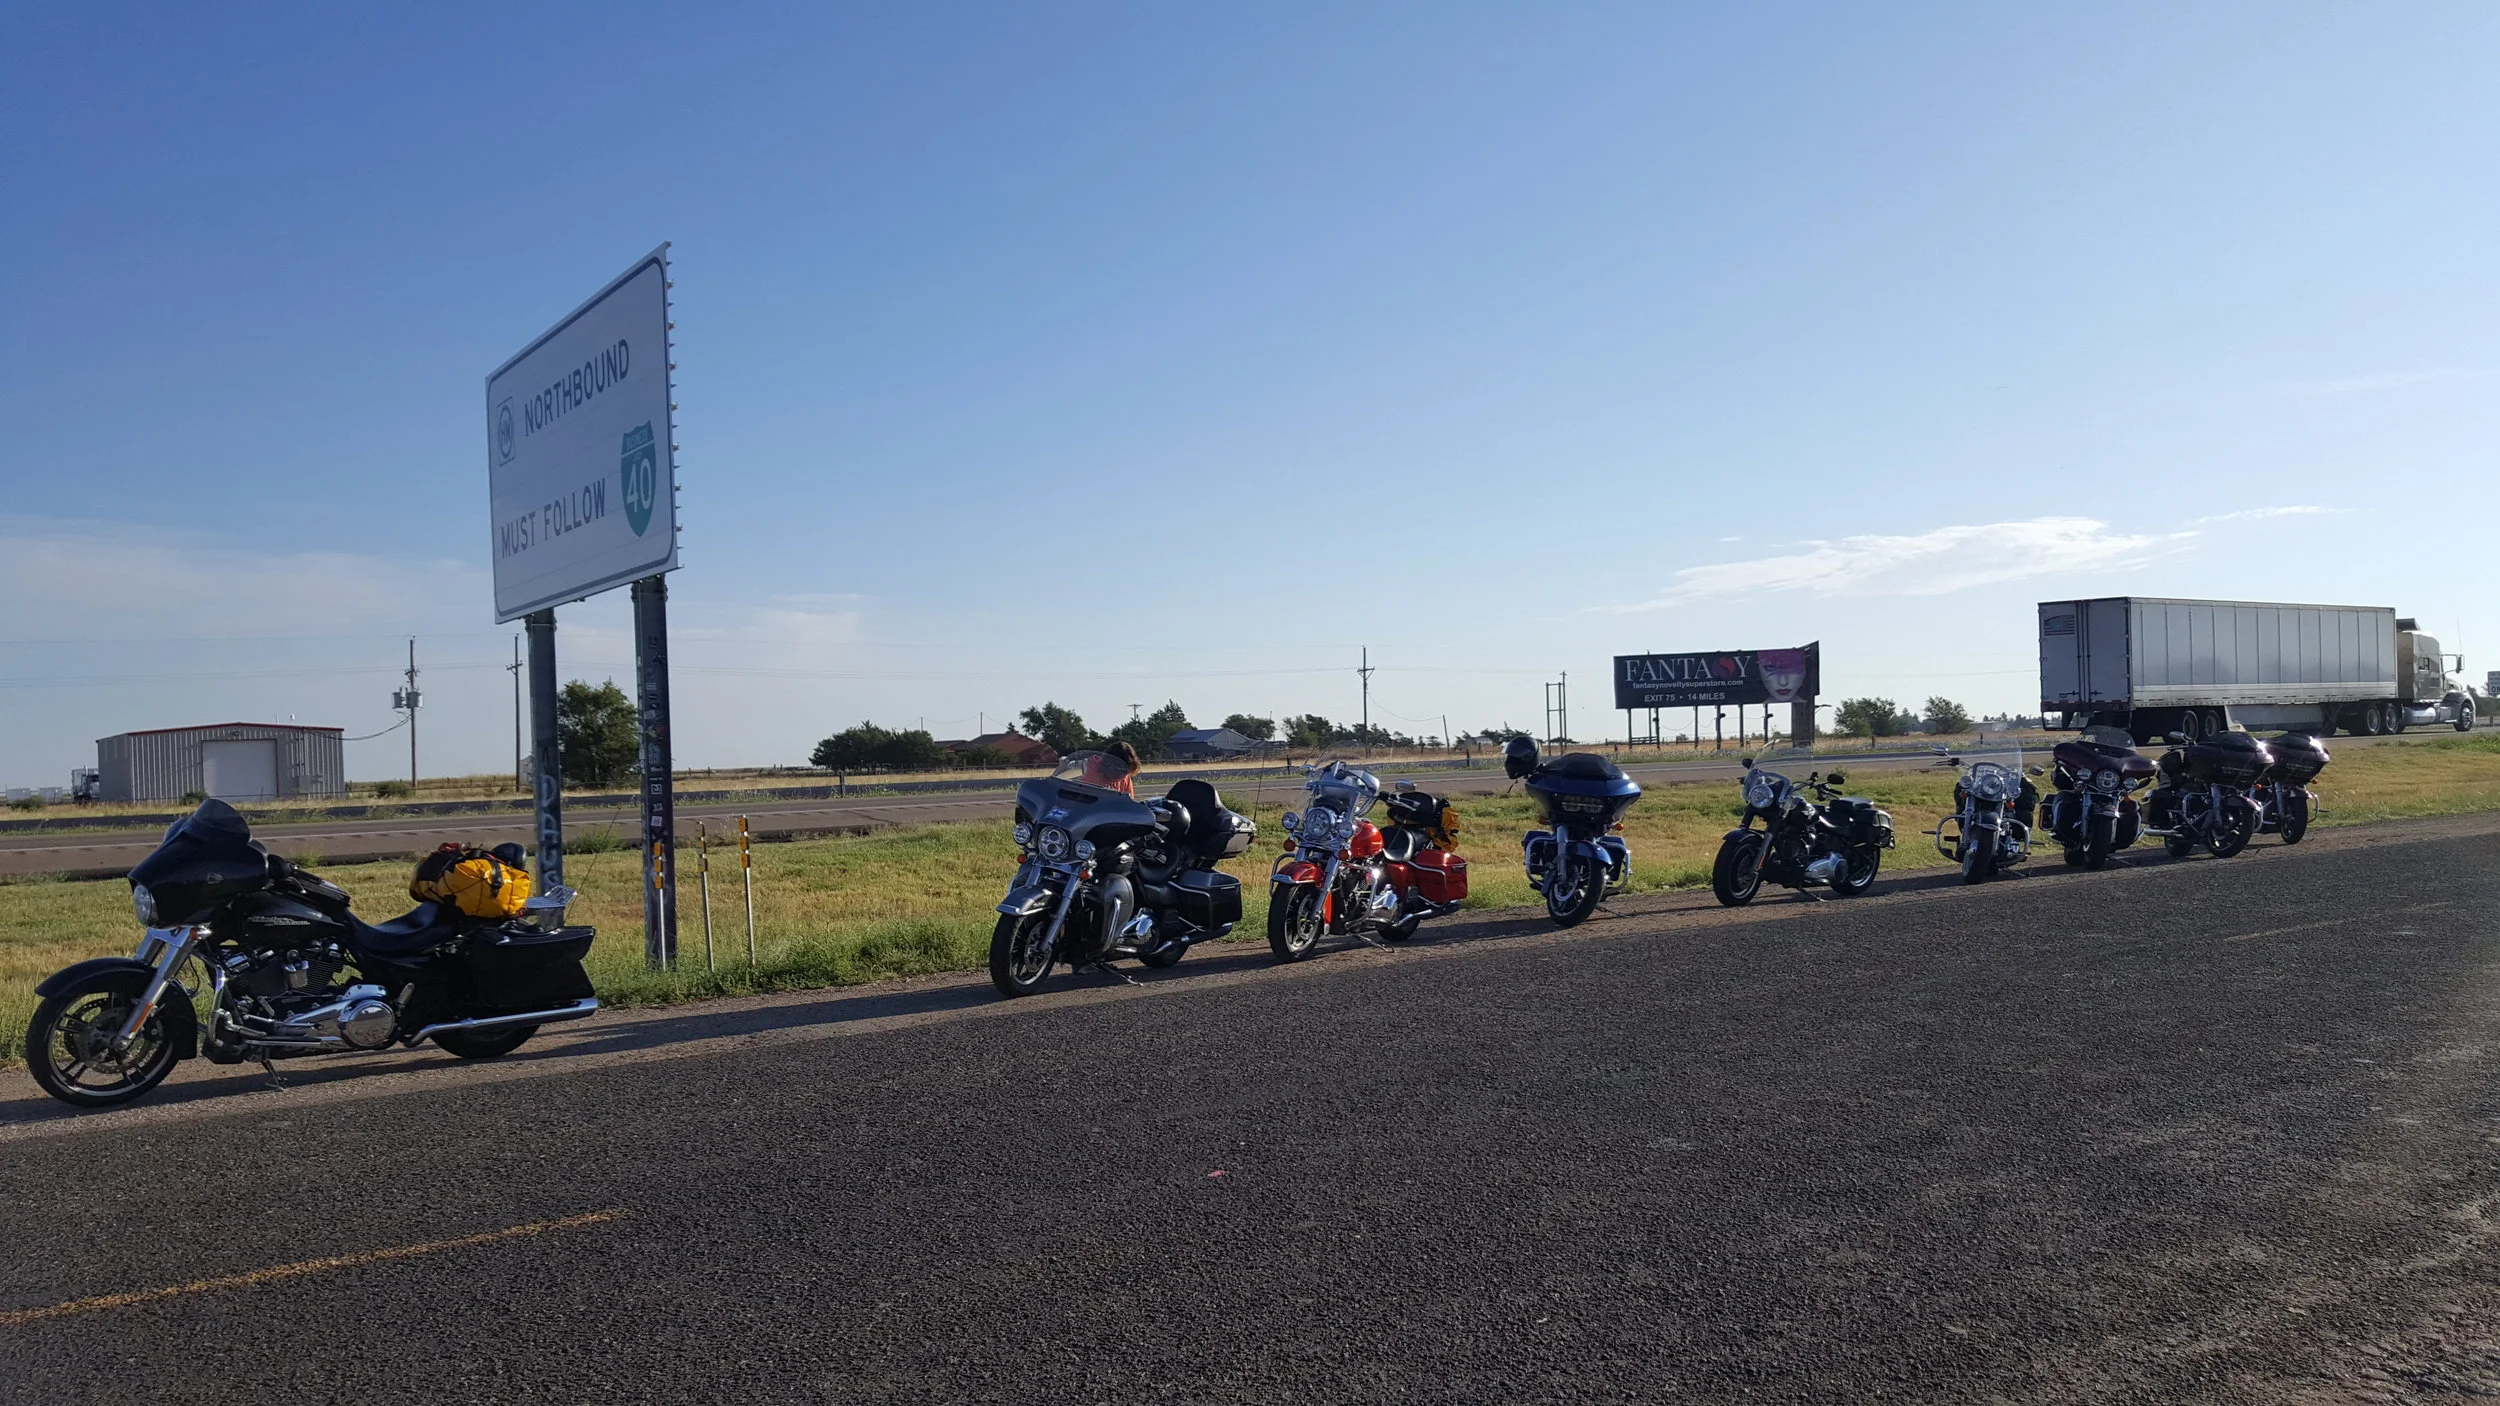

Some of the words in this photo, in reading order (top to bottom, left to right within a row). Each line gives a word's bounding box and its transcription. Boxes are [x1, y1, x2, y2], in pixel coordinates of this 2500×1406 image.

[525, 339, 629, 437] NORTHBOUND
[626, 458, 652, 513] 40
[501, 511, 536, 559] MUST
[544, 478, 605, 541] FOLLOW
[1632, 680, 1744, 690] fantasynoveltysuperstore.com
[1644, 694, 1664, 702] EXIT
[1665, 693, 1676, 702] 75
[1687, 693, 1697, 701] 14
[1699, 692, 1726, 701] MILES
